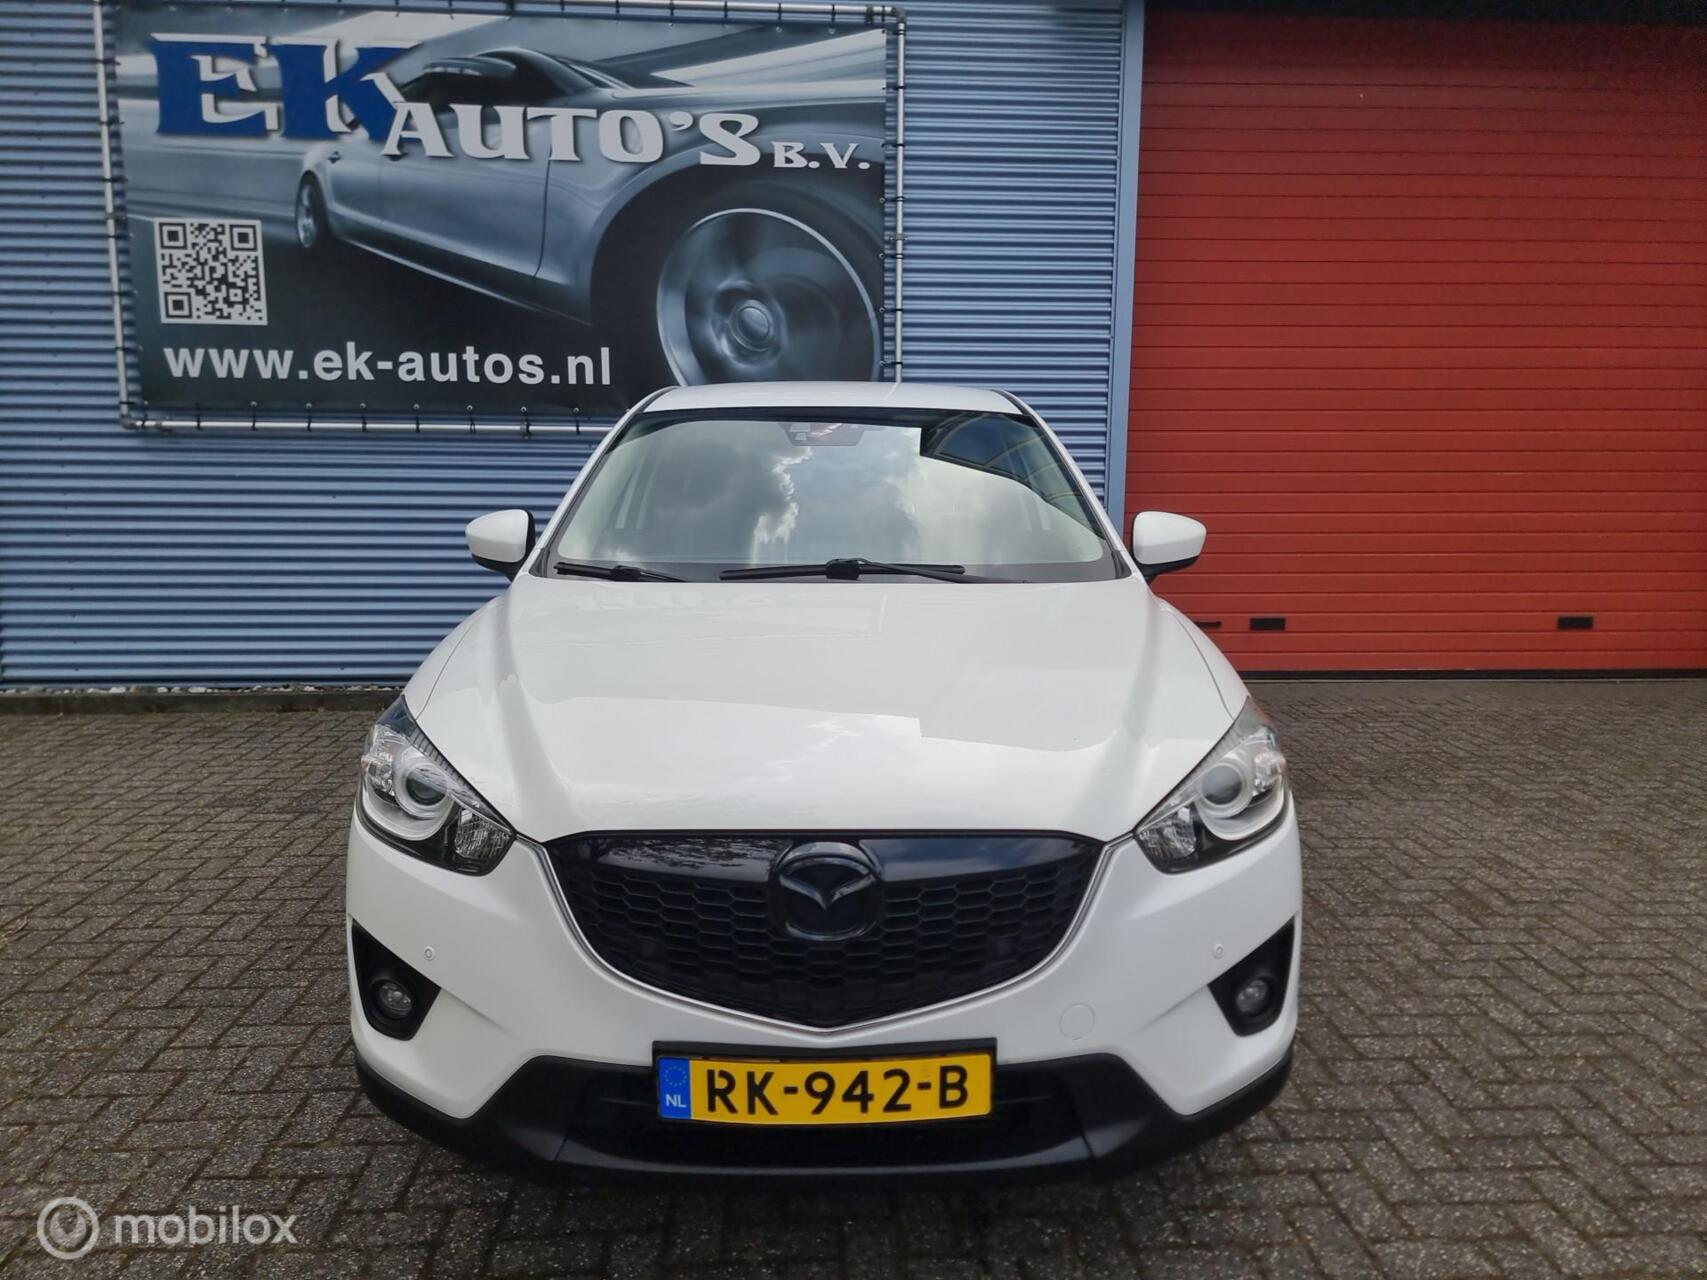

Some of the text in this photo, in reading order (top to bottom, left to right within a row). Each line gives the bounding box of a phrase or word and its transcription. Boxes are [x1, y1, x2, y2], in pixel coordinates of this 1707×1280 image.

[150, 33, 417, 140] EK
[773, 142, 871, 169] B.V.
[163, 341, 611, 386] www.ek-autos.nl
[665, 1094, 687, 1108] NL
[706, 1065, 969, 1115] RK-942-B
